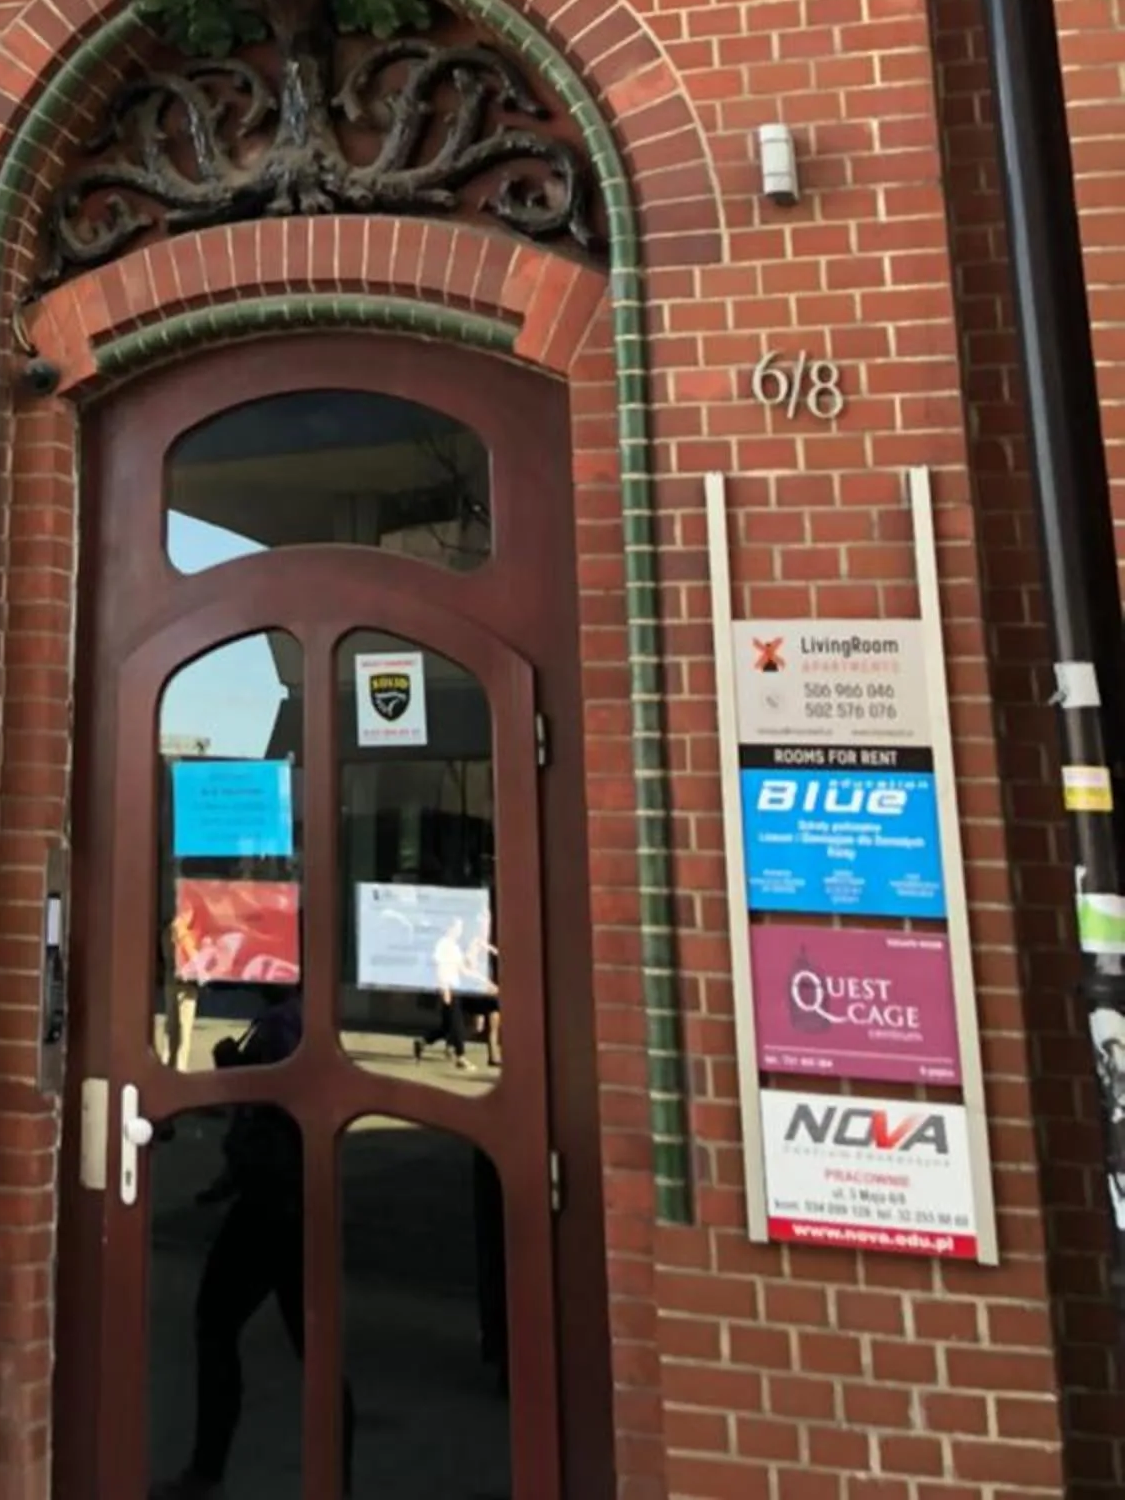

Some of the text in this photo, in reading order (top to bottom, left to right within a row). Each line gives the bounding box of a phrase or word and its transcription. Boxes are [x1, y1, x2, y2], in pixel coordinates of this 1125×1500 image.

[752, 350, 844, 419] 6/8
[801, 635, 899, 658] LivingRoom
[805, 702, 832, 718] 502
[774, 748, 898, 766] ROOMS FOR RENT
[791, 970, 892, 1023] QUEST
[847, 1002, 920, 1028] CAGE
[784, 1104, 949, 1154] NOVA
[791, 1223, 955, 1252] www.nova.edu.pl
